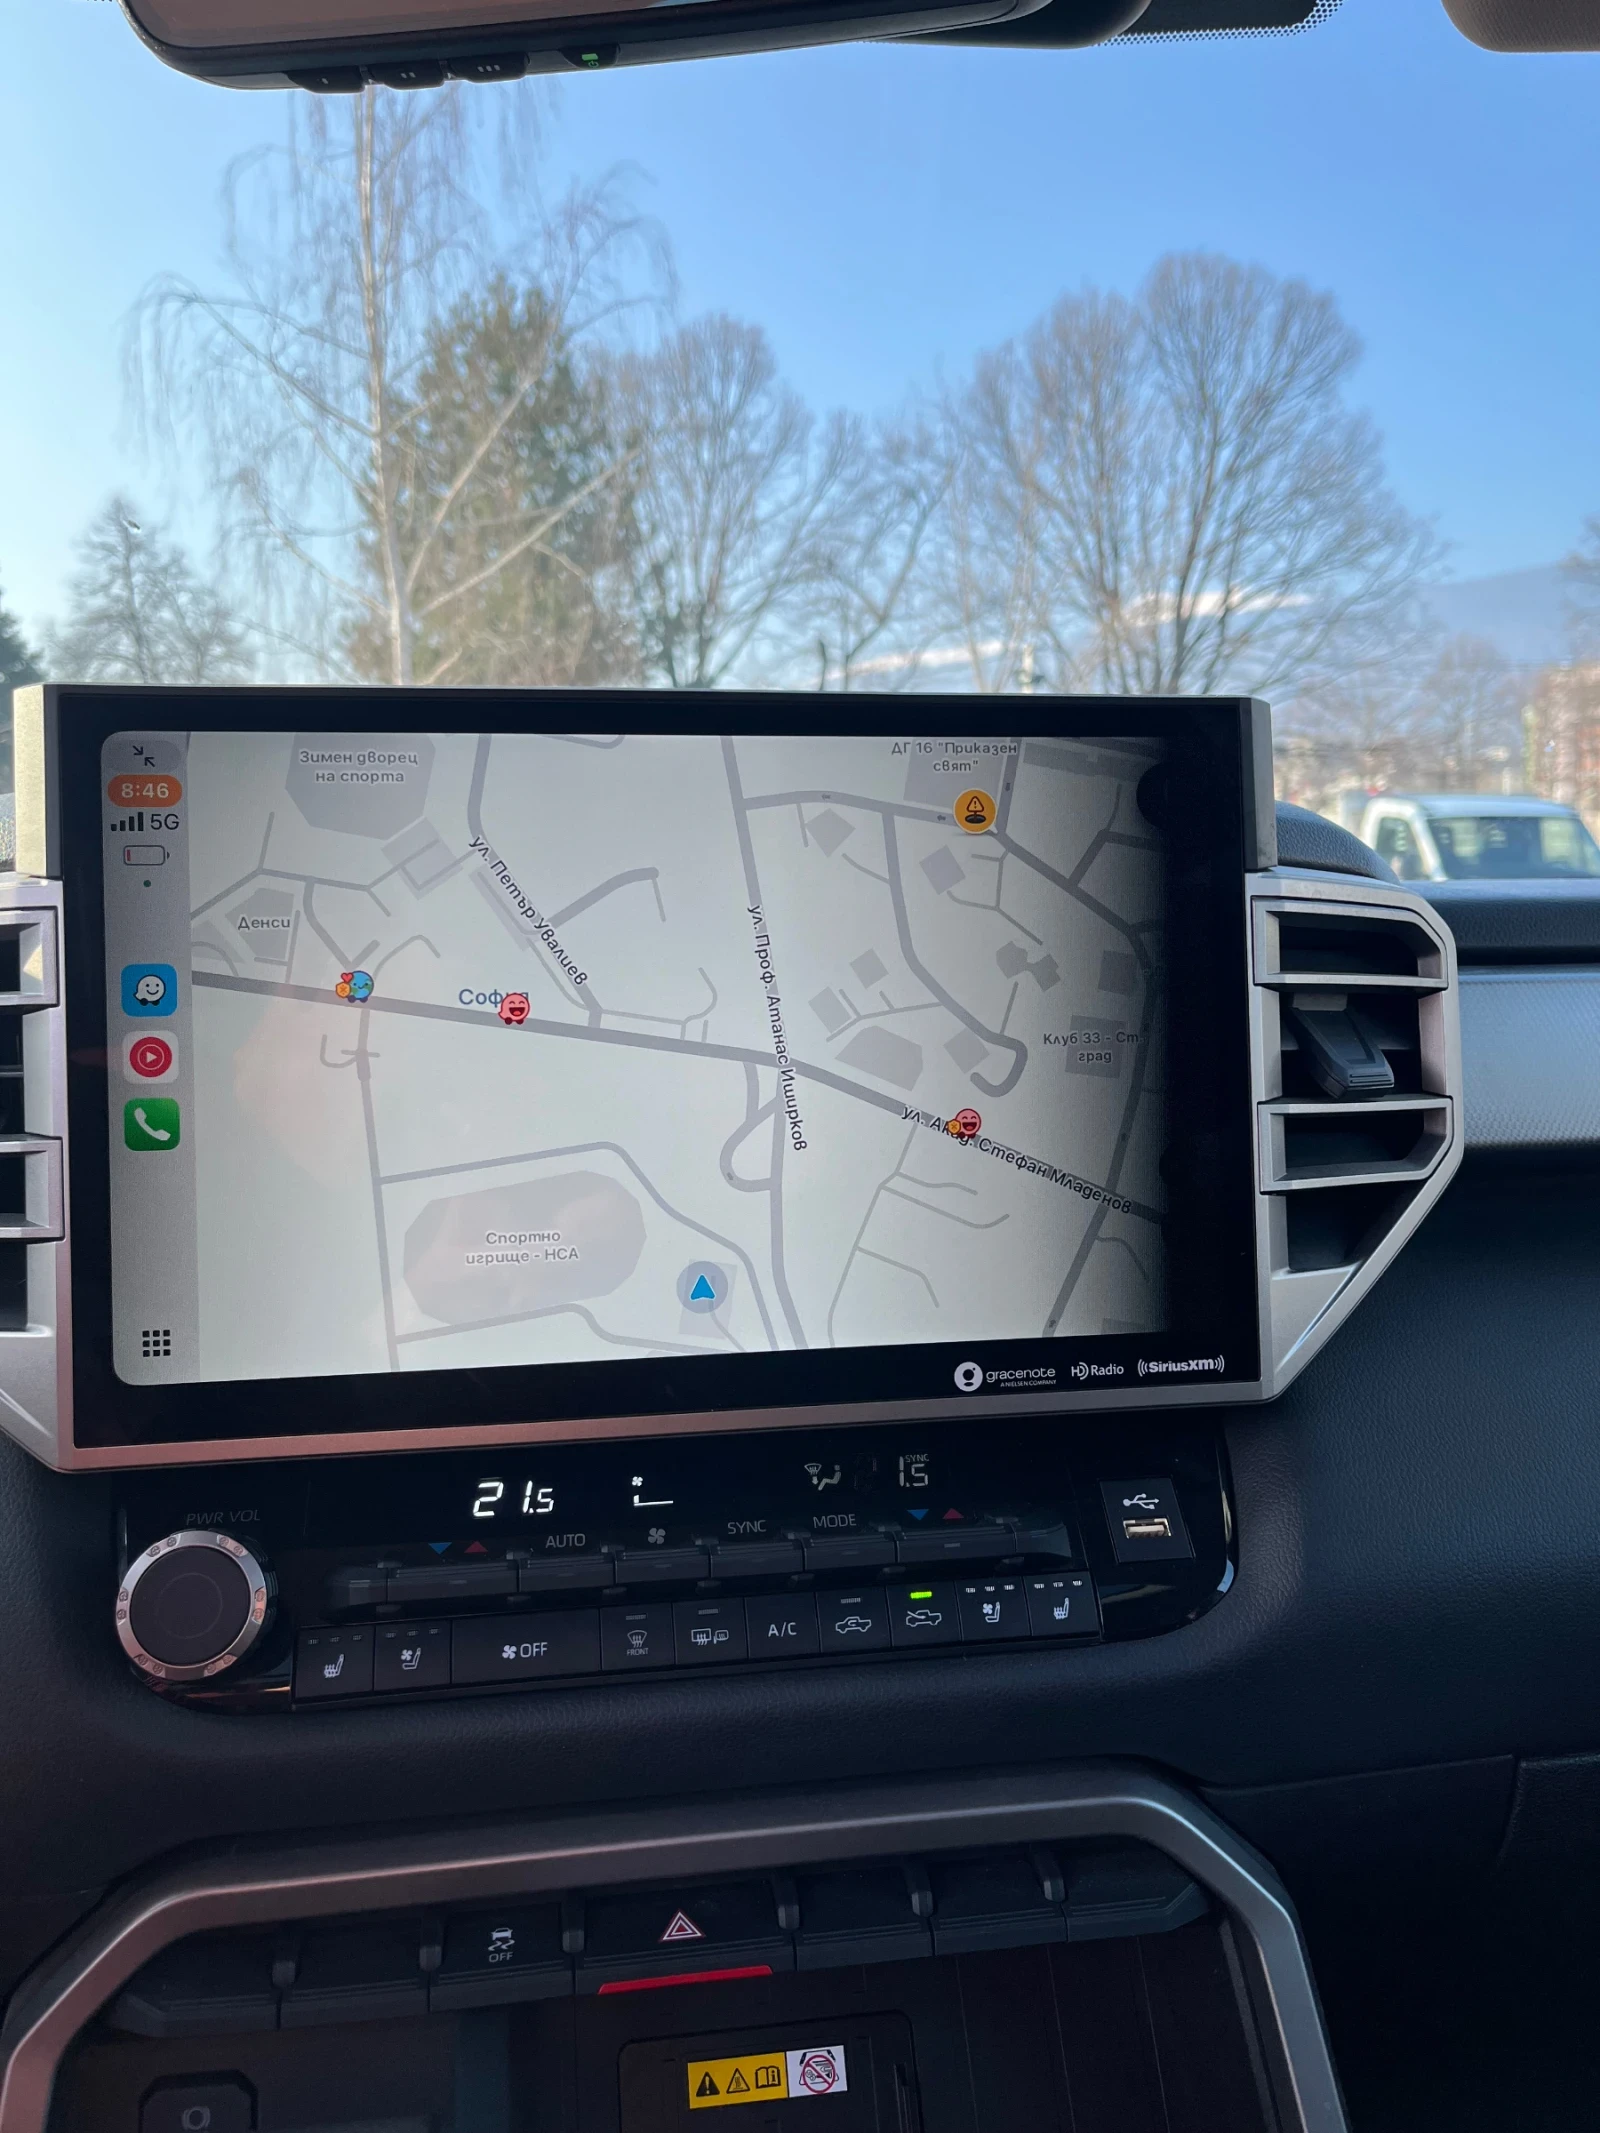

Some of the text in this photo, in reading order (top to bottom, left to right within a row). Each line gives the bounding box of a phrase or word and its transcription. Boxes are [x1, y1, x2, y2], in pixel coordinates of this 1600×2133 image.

[891, 741, 1018, 756] ДГ 16 "Приказен
[299, 750, 418, 766] Зимен дворец
[933, 760, 979, 772] свят"
[315, 772, 405, 784] на спорта
[121, 783, 169, 798] 8:46
[150, 813, 180, 830] 5G
[469, 836, 588, 985] ул. Петър Увалиев
[237, 917, 291, 930] Денси
[458, 988, 529, 1008] Соф
[747, 905, 808, 1151] ул. Проф. Атанас Иширков
[1043, 1032, 1078, 1047] Клуб
[1083, 1032, 1101, 1043] 33
[1078, 1051, 1112, 1064] град
[901, 1105, 924, 1125] ул.
[978, 1137, 1048, 1178] Стефан
[1049, 1168, 1132, 1215] Младенов
[485, 1231, 561, 1246] Спортно
[465, 1251, 530, 1266] игрище
[544, 1247, 579, 1261] НСА
[985, 1367, 1056, 1383] gracenote
[1090, 1362, 1125, 1377] Radio
[904, 1453, 930, 1462] SYNC
[186, 1509, 261, 1526] PWR VOL
[812, 1514, 857, 1529] MODE
[727, 1520, 767, 1535] SYNC
[545, 1533, 586, 1549] AUTO
[767, 1622, 797, 1637] A/C
[520, 1642, 548, 1659] OFF
[626, 1647, 649, 1656] FRONT
[488, 1952, 513, 1963] OFF
